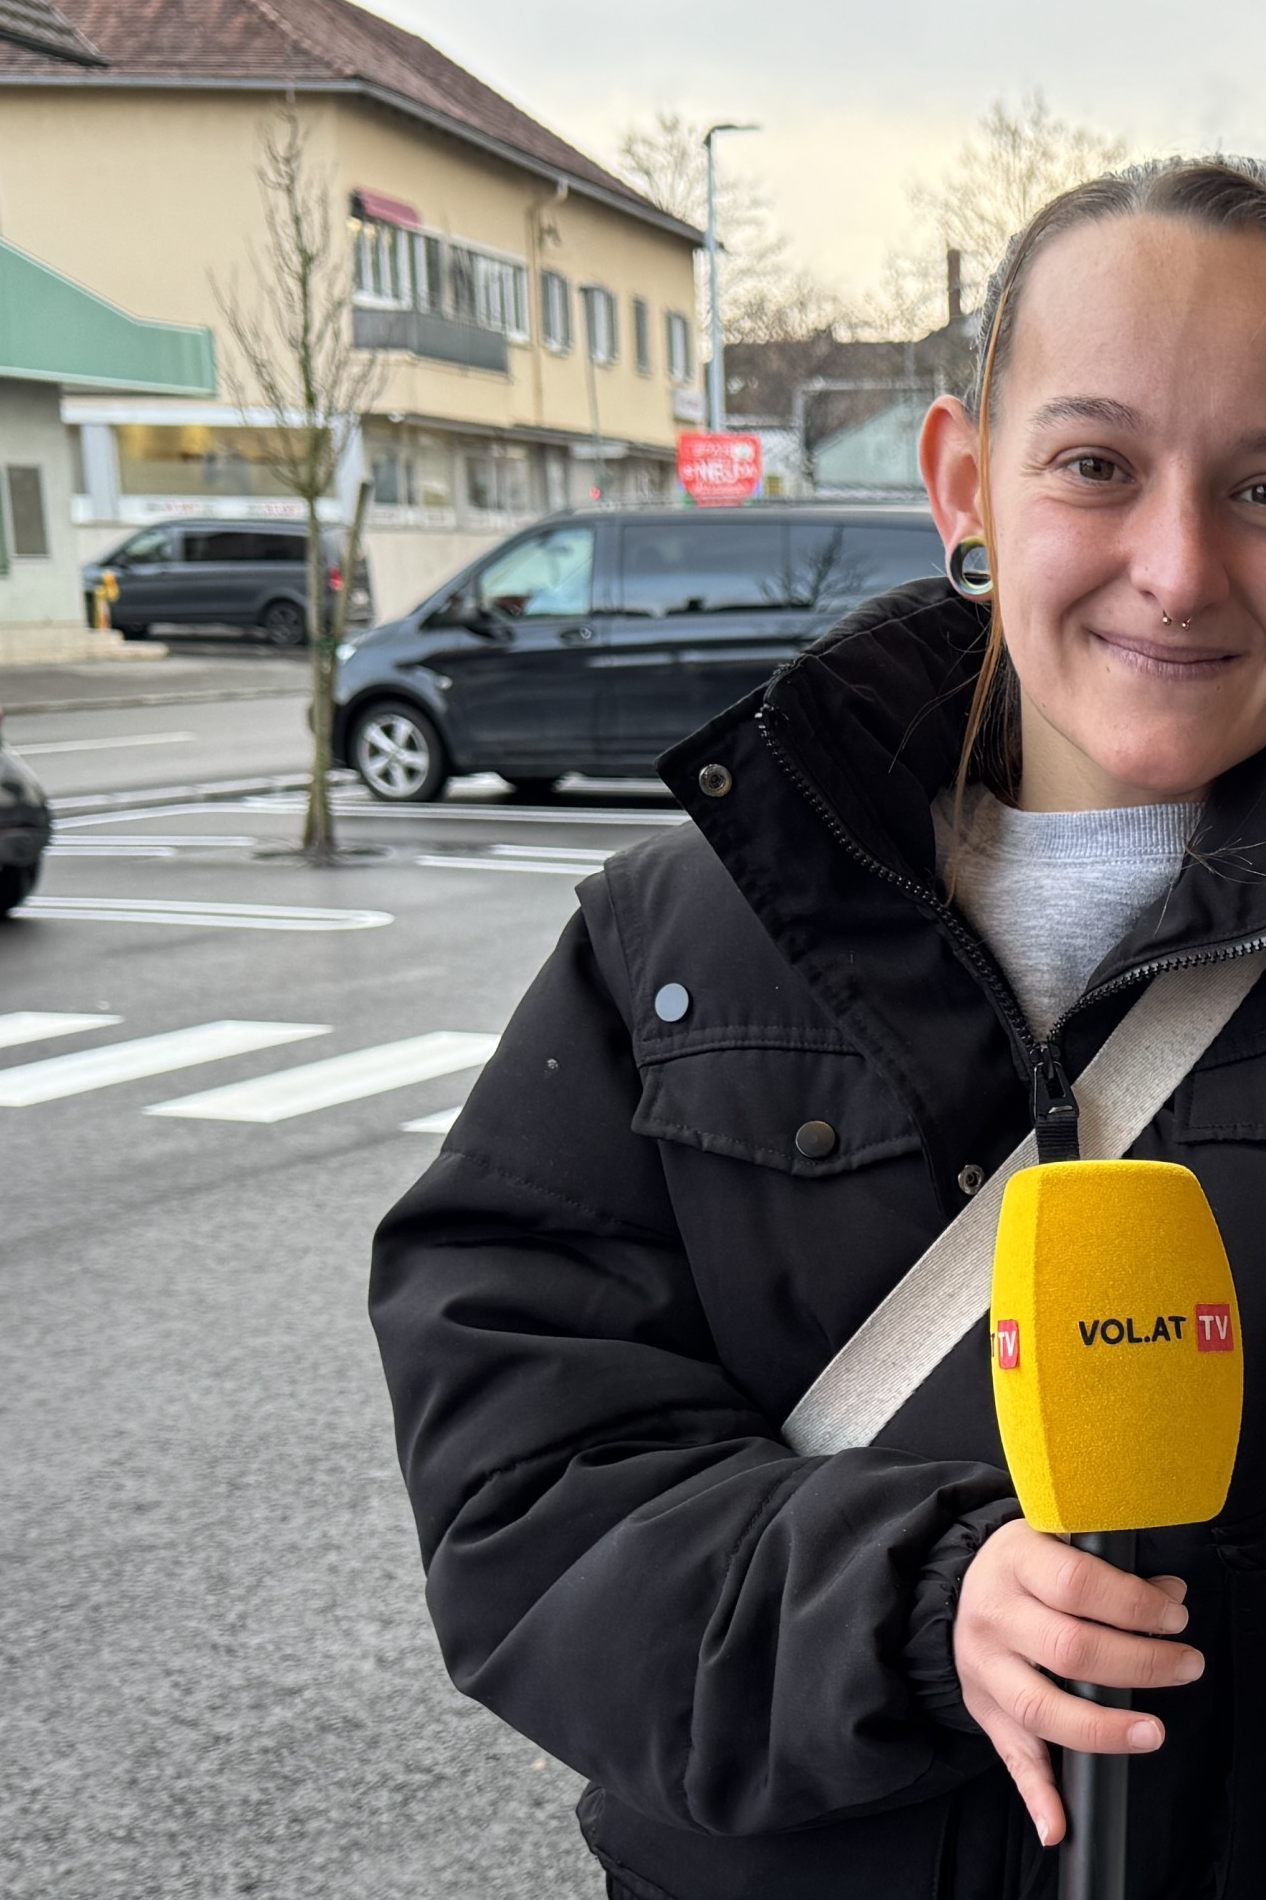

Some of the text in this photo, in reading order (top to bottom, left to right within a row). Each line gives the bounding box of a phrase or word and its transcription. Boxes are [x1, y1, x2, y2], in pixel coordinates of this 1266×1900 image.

[998, 1331, 1017, 1358] TV
[1078, 1315, 1229, 1346] VOL.AT TV
